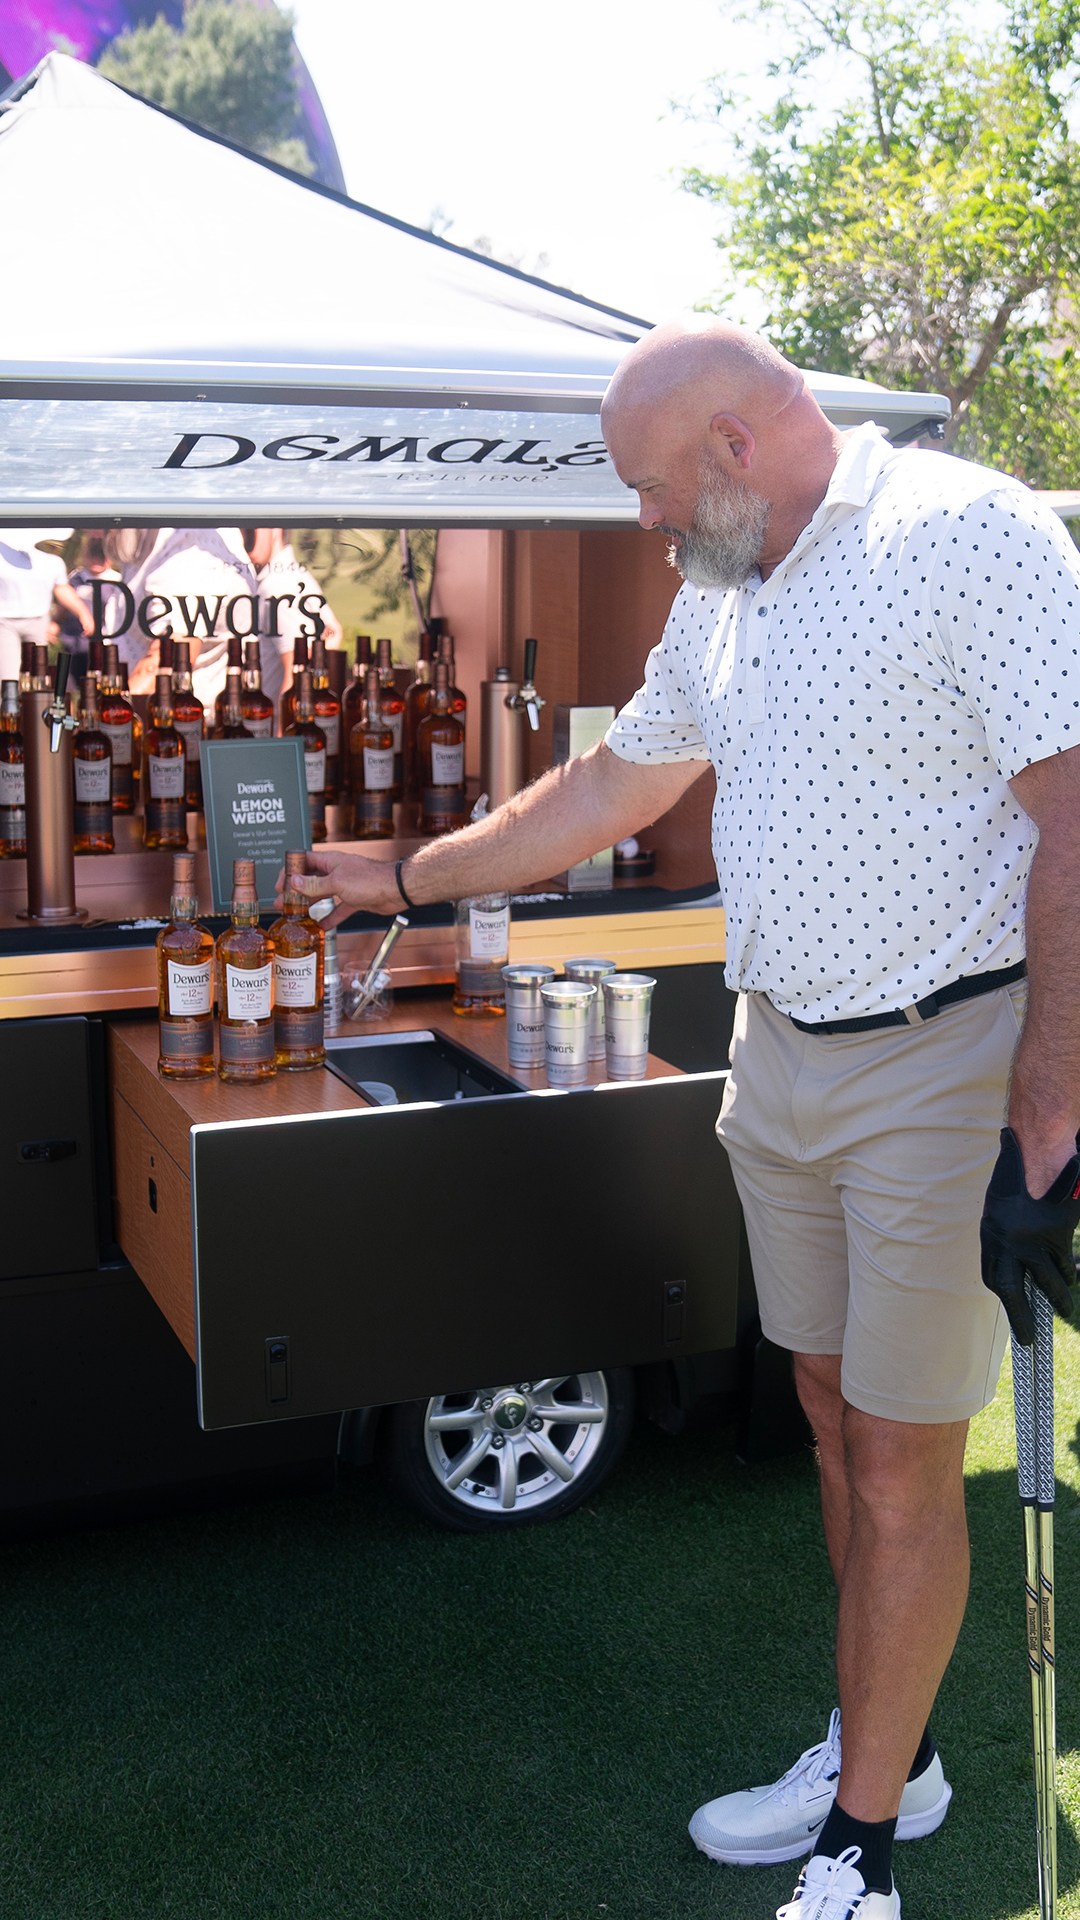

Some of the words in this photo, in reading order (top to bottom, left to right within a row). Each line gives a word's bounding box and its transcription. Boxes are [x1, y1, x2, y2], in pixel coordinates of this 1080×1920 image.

[86, 579, 327, 639] Dewar's
[78, 767, 108, 778] Dewar's
[152, 763, 182, 774] Dewar's
[237, 781, 275, 795] Dewar's
[232, 798, 283, 813] LEMON
[231, 810, 286, 825] WEDGE
[474, 919, 506, 930] Dewar's
[275, 964, 312, 977] Dewar's
[173, 972, 210, 985] Dewar's
[231, 976, 269, 988] Dewar's
[288, 981, 297, 990] 12
[188, 988, 197, 998] 12
[246, 993, 255, 1002] 12
[1041, 1596, 1050, 1626] Dynamic
[1028, 1607, 1037, 1636] Dynamic
[1043, 1626, 1051, 1642] Gold
[1030, 1636, 1038, 1652] Gold
